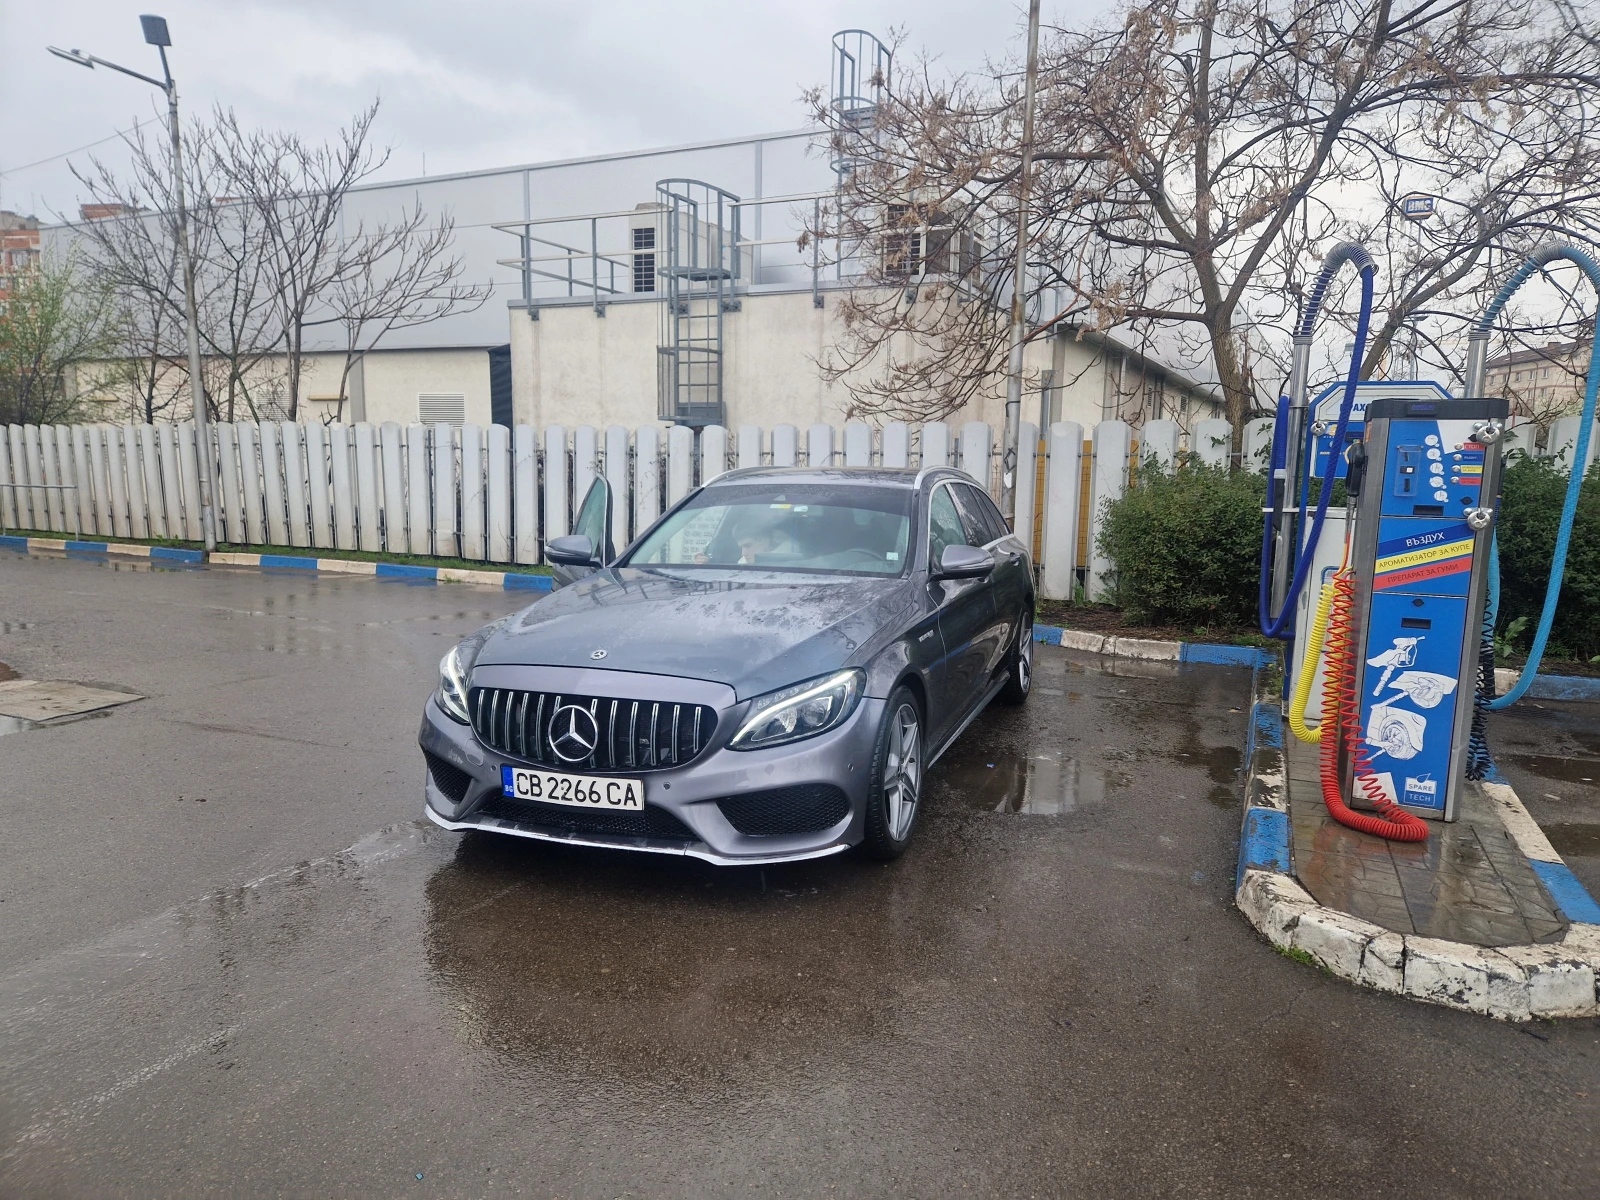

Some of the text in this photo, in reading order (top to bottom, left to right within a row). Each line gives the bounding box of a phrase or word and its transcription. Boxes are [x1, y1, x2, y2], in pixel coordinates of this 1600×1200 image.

[1405, 532, 1445, 547] ВЪЗДУХ
[1379, 543, 1471, 568] АРОМАТИЗАТОР ЗА КУПЕ
[1387, 563, 1459, 583] ПРЕПАРАТ ЗА ГУМИ
[516, 772, 543, 797] CB
[546, 776, 601, 804] 2266
[606, 782, 638, 807] CA
[1408, 783, 1433, 792] SPARE
[1409, 793, 1431, 802] TECH
